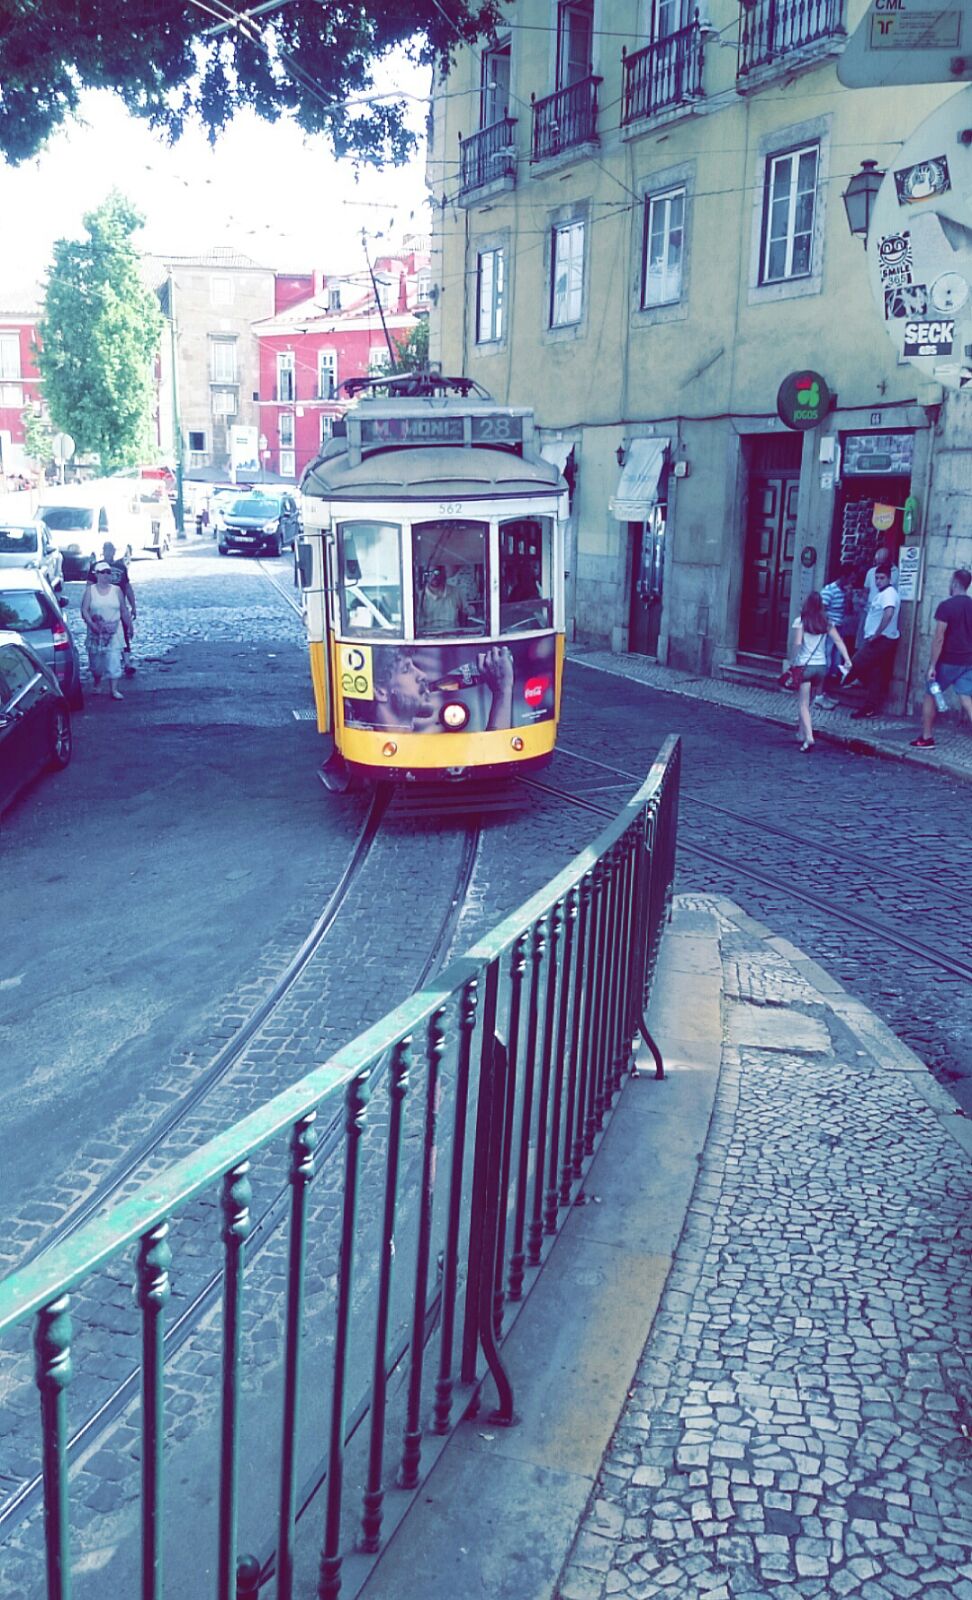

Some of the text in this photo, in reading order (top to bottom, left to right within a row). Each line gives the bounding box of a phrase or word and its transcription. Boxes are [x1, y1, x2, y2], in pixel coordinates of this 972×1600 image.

[875, 0, 906, 10] CML
[883, 265, 910, 277] SMILE
[888, 276, 907, 286] 365
[905, 322, 954, 344] SECK
[793, 409, 818, 422] JOGOS
[402, 420, 462, 436] MONIZ
[480, 419, 510, 438] 28
[439, 504, 463, 514] 562
